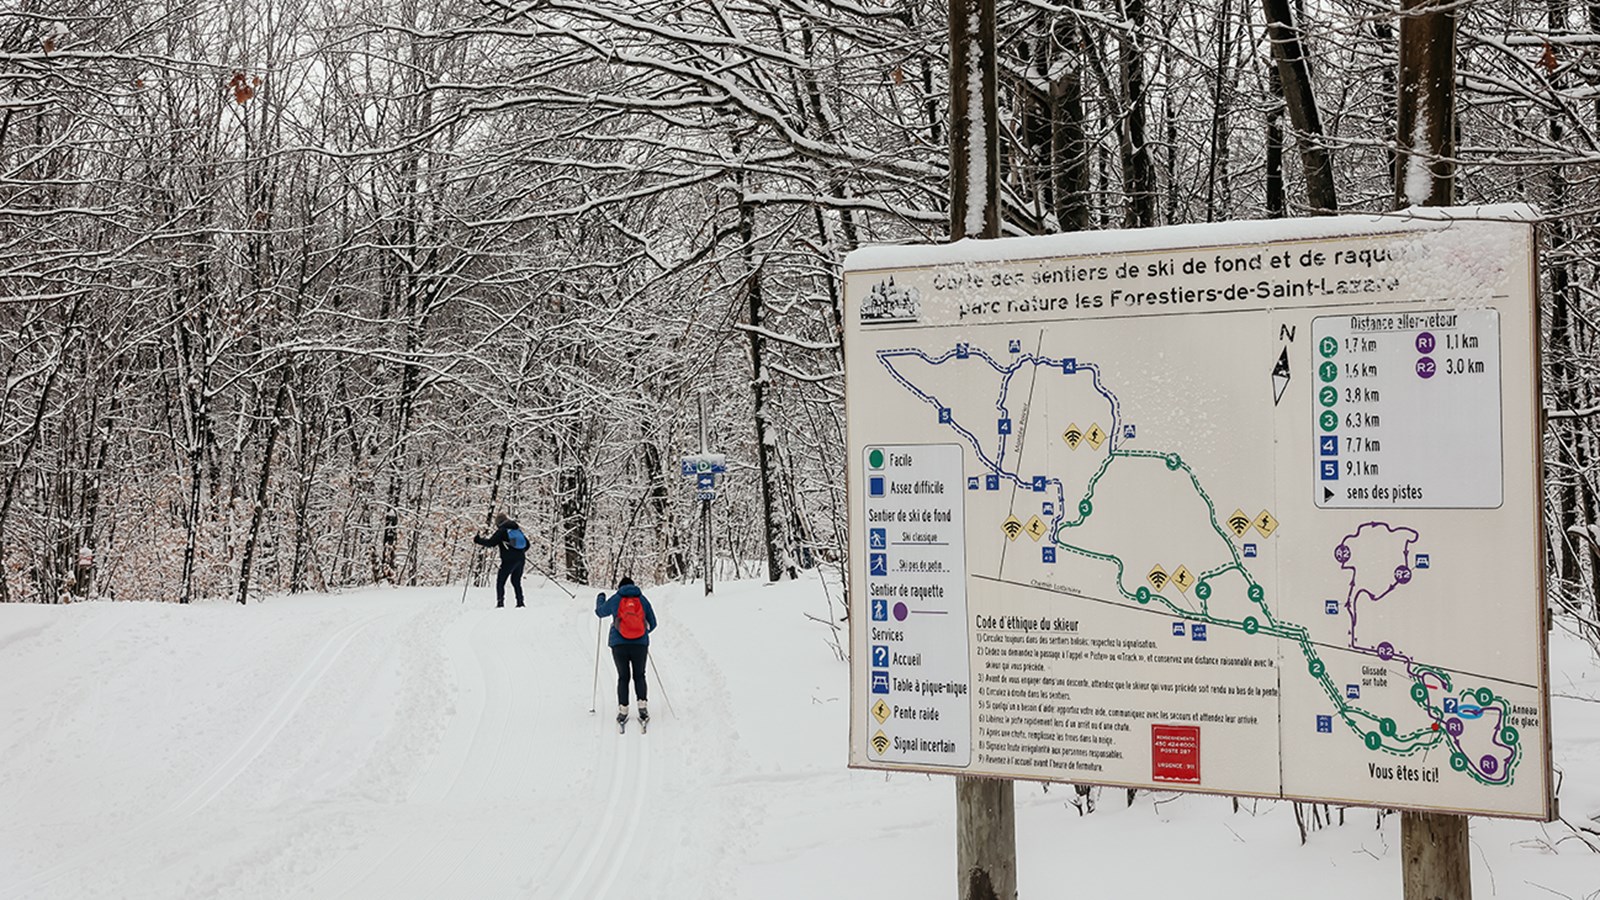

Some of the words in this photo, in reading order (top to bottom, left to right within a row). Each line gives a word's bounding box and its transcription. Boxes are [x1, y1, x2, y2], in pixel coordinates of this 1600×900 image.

[1032, 265, 1108, 285] sentiers
[1116, 262, 1139, 279] de
[1148, 259, 1174, 277] ski
[1183, 258, 1207, 275] de
[1214, 255, 1262, 273] fond
[1270, 251, 1291, 269] et
[1300, 249, 1326, 267] de
[960, 301, 1000, 320] parc
[1008, 296, 1068, 312] nature
[1076, 292, 1103, 308] les
[1350, 316, 1394, 331] Distance
[1397, 314, 1458, 330] aller-retour
[1280, 323, 1296, 342] N
[1362, 338, 1376, 352] km
[1418, 337, 1433, 348] R1
[1462, 334, 1478, 348] km
[1362, 363, 1377, 377] km
[1417, 362, 1435, 373] R2
[1468, 359, 1484, 374] km
[1364, 388, 1380, 402] km
[1364, 413, 1380, 427] km
[1364, 438, 1380, 452] km
[890, 453, 912, 466] Facile
[1364, 461, 1378, 476] km
[890, 481, 912, 494] Assez
[914, 481, 944, 494] difficile
[1347, 486, 1368, 499] sens
[1372, 485, 1389, 499] des
[1392, 484, 1422, 502] pistes
[869, 508, 895, 522] Sentier
[897, 509, 906, 522] de
[908, 509, 920, 522] ski
[922, 509, 930, 522] de
[934, 508, 952, 522] fond
[902, 532, 912, 542] Ski
[912, 532, 938, 544] classique
[899, 560, 908, 570] Ski
[909, 562, 918, 570] pas
[920, 560, 927, 570] de
[928, 560, 942, 570] patin
[870, 582, 896, 596] Sentier
[900, 584, 908, 597] de
[910, 584, 944, 600] raquette
[976, 614, 996, 629] Code
[999, 616, 1038, 633] d'éthique
[1040, 617, 1051, 630] du
[1054, 618, 1079, 632] skieur
[872, 627, 904, 642] Services
[892, 652, 922, 666] Accueil
[1154, 655, 1182, 664] conservez
[1254, 659, 1267, 668] avec
[1268, 658, 1274, 668] le
[1362, 666, 1388, 676] Glissade
[893, 678, 912, 692] Table
[916, 678, 920, 692] à
[922, 680, 968, 698] pique-nique
[1362, 678, 1372, 686] sur
[1372, 677, 1388, 687] tube
[894, 706, 916, 720] Pente
[919, 706, 940, 721] raide
[1512, 705, 1538, 716] Anneau
[1511, 716, 1521, 726] de
[1522, 716, 1538, 728] glace
[894, 736, 918, 754] Signal
[920, 738, 956, 753] incertain
[1368, 763, 1394, 780] Vous
[1396, 764, 1420, 782] êtes
[1422, 766, 1440, 783] ici!
